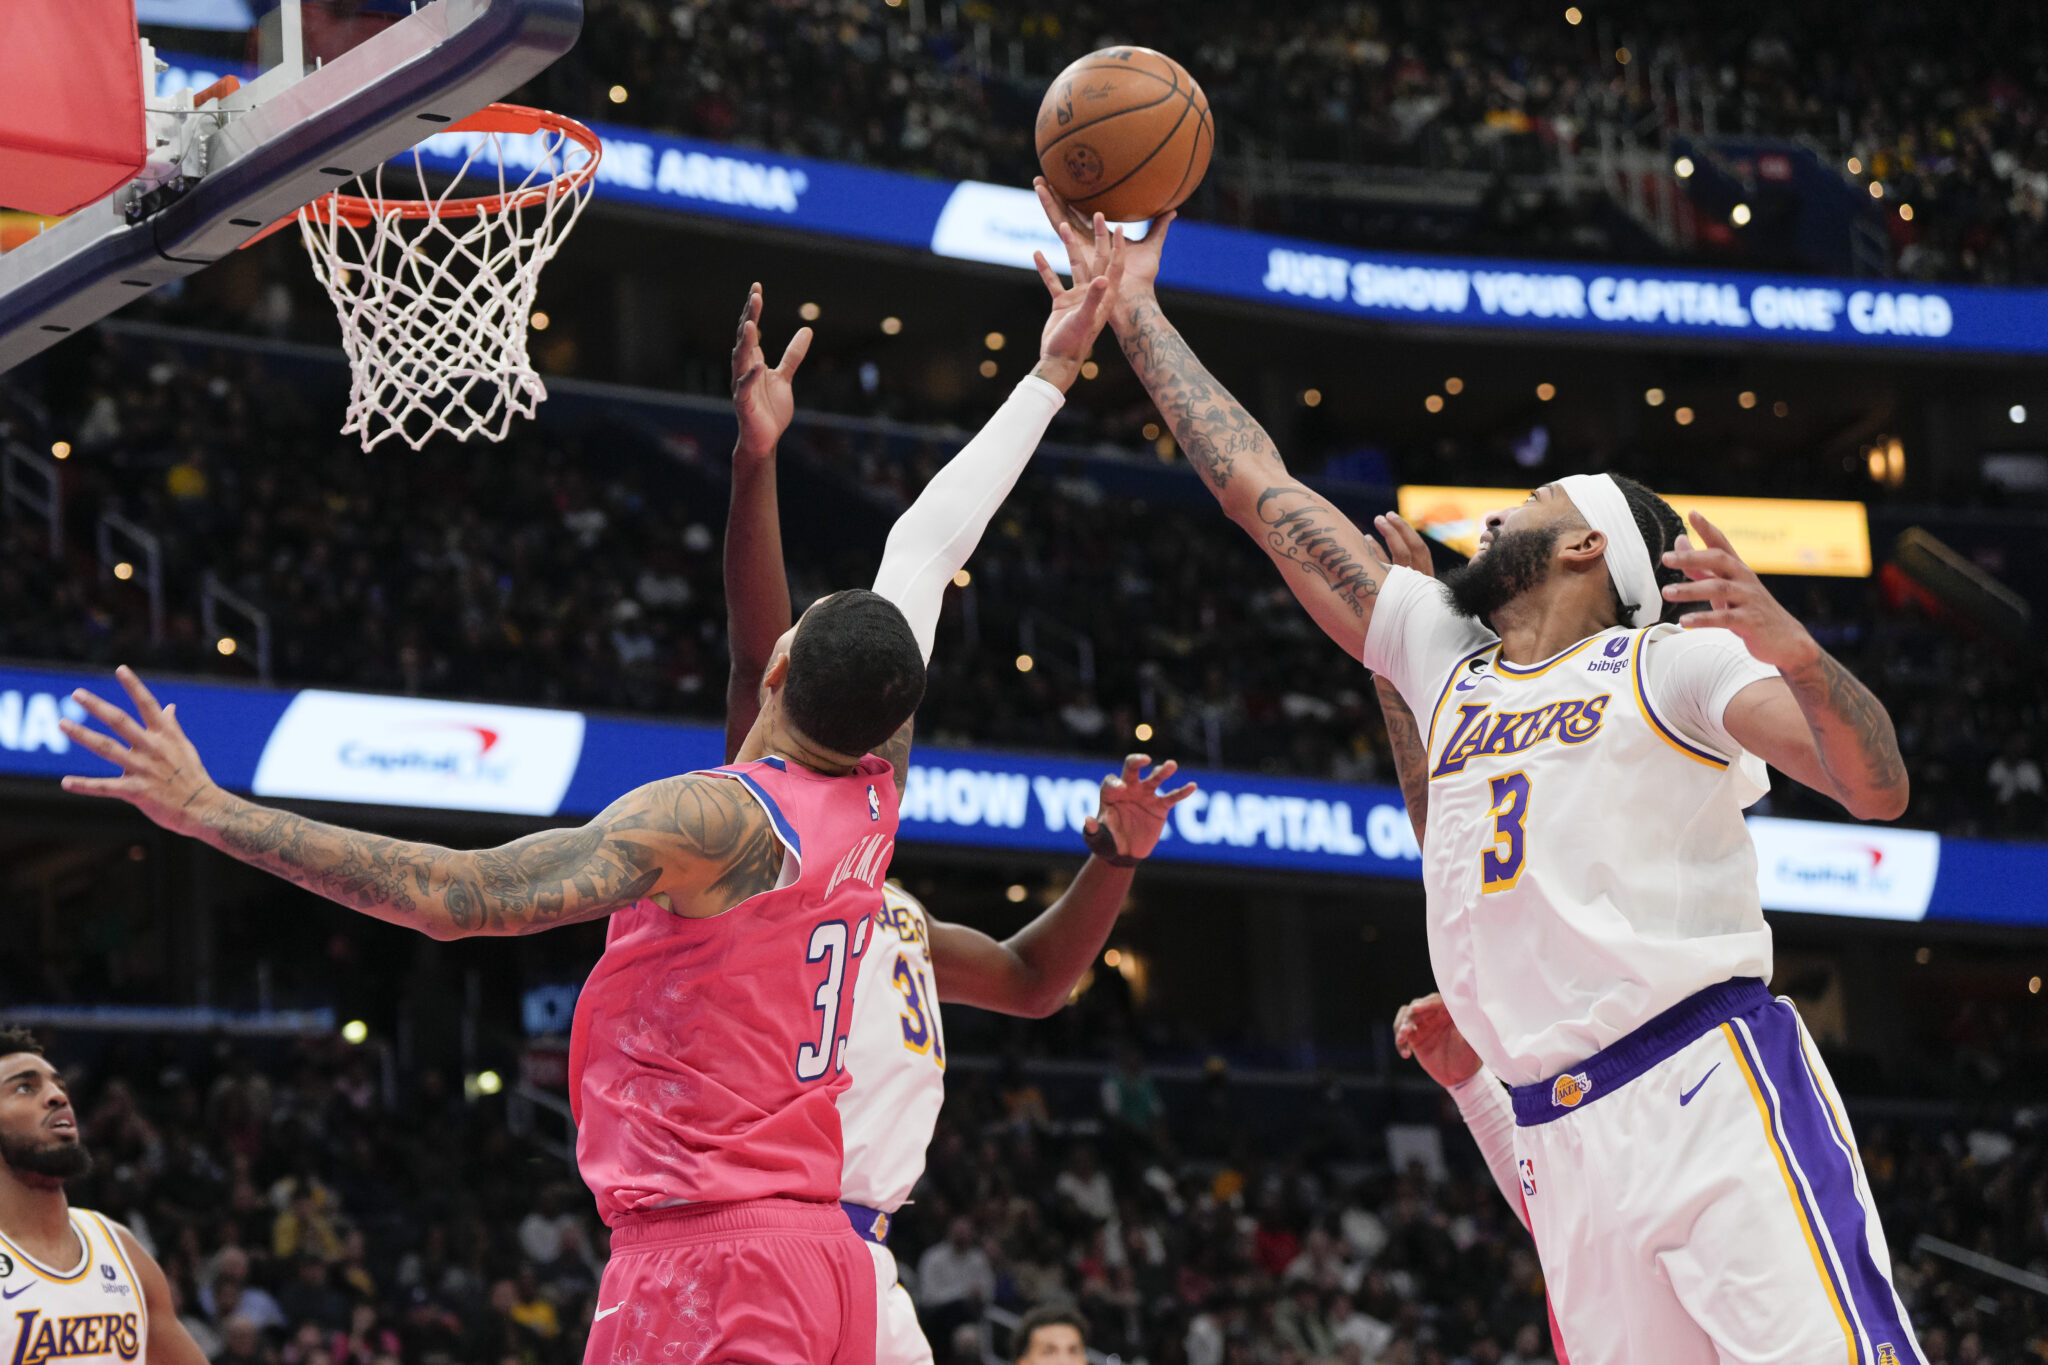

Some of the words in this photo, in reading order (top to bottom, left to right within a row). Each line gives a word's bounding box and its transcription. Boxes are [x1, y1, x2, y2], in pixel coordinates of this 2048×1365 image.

[1263, 248, 1349, 302] JUST
[1350, 261, 1471, 314] SHOW
[1471, 270, 1588, 320] YOUR
[1588, 276, 1750, 328] CAPITAL
[1848, 290, 1953, 337] CARD
[1586, 658, 1629, 674] bibigo
[1429, 693, 1612, 781] LAKERS
[1174, 787, 1367, 857] CAPITAL
[1481, 770, 1532, 895] 3
[8, 1308, 139, 1365] LAKERS
